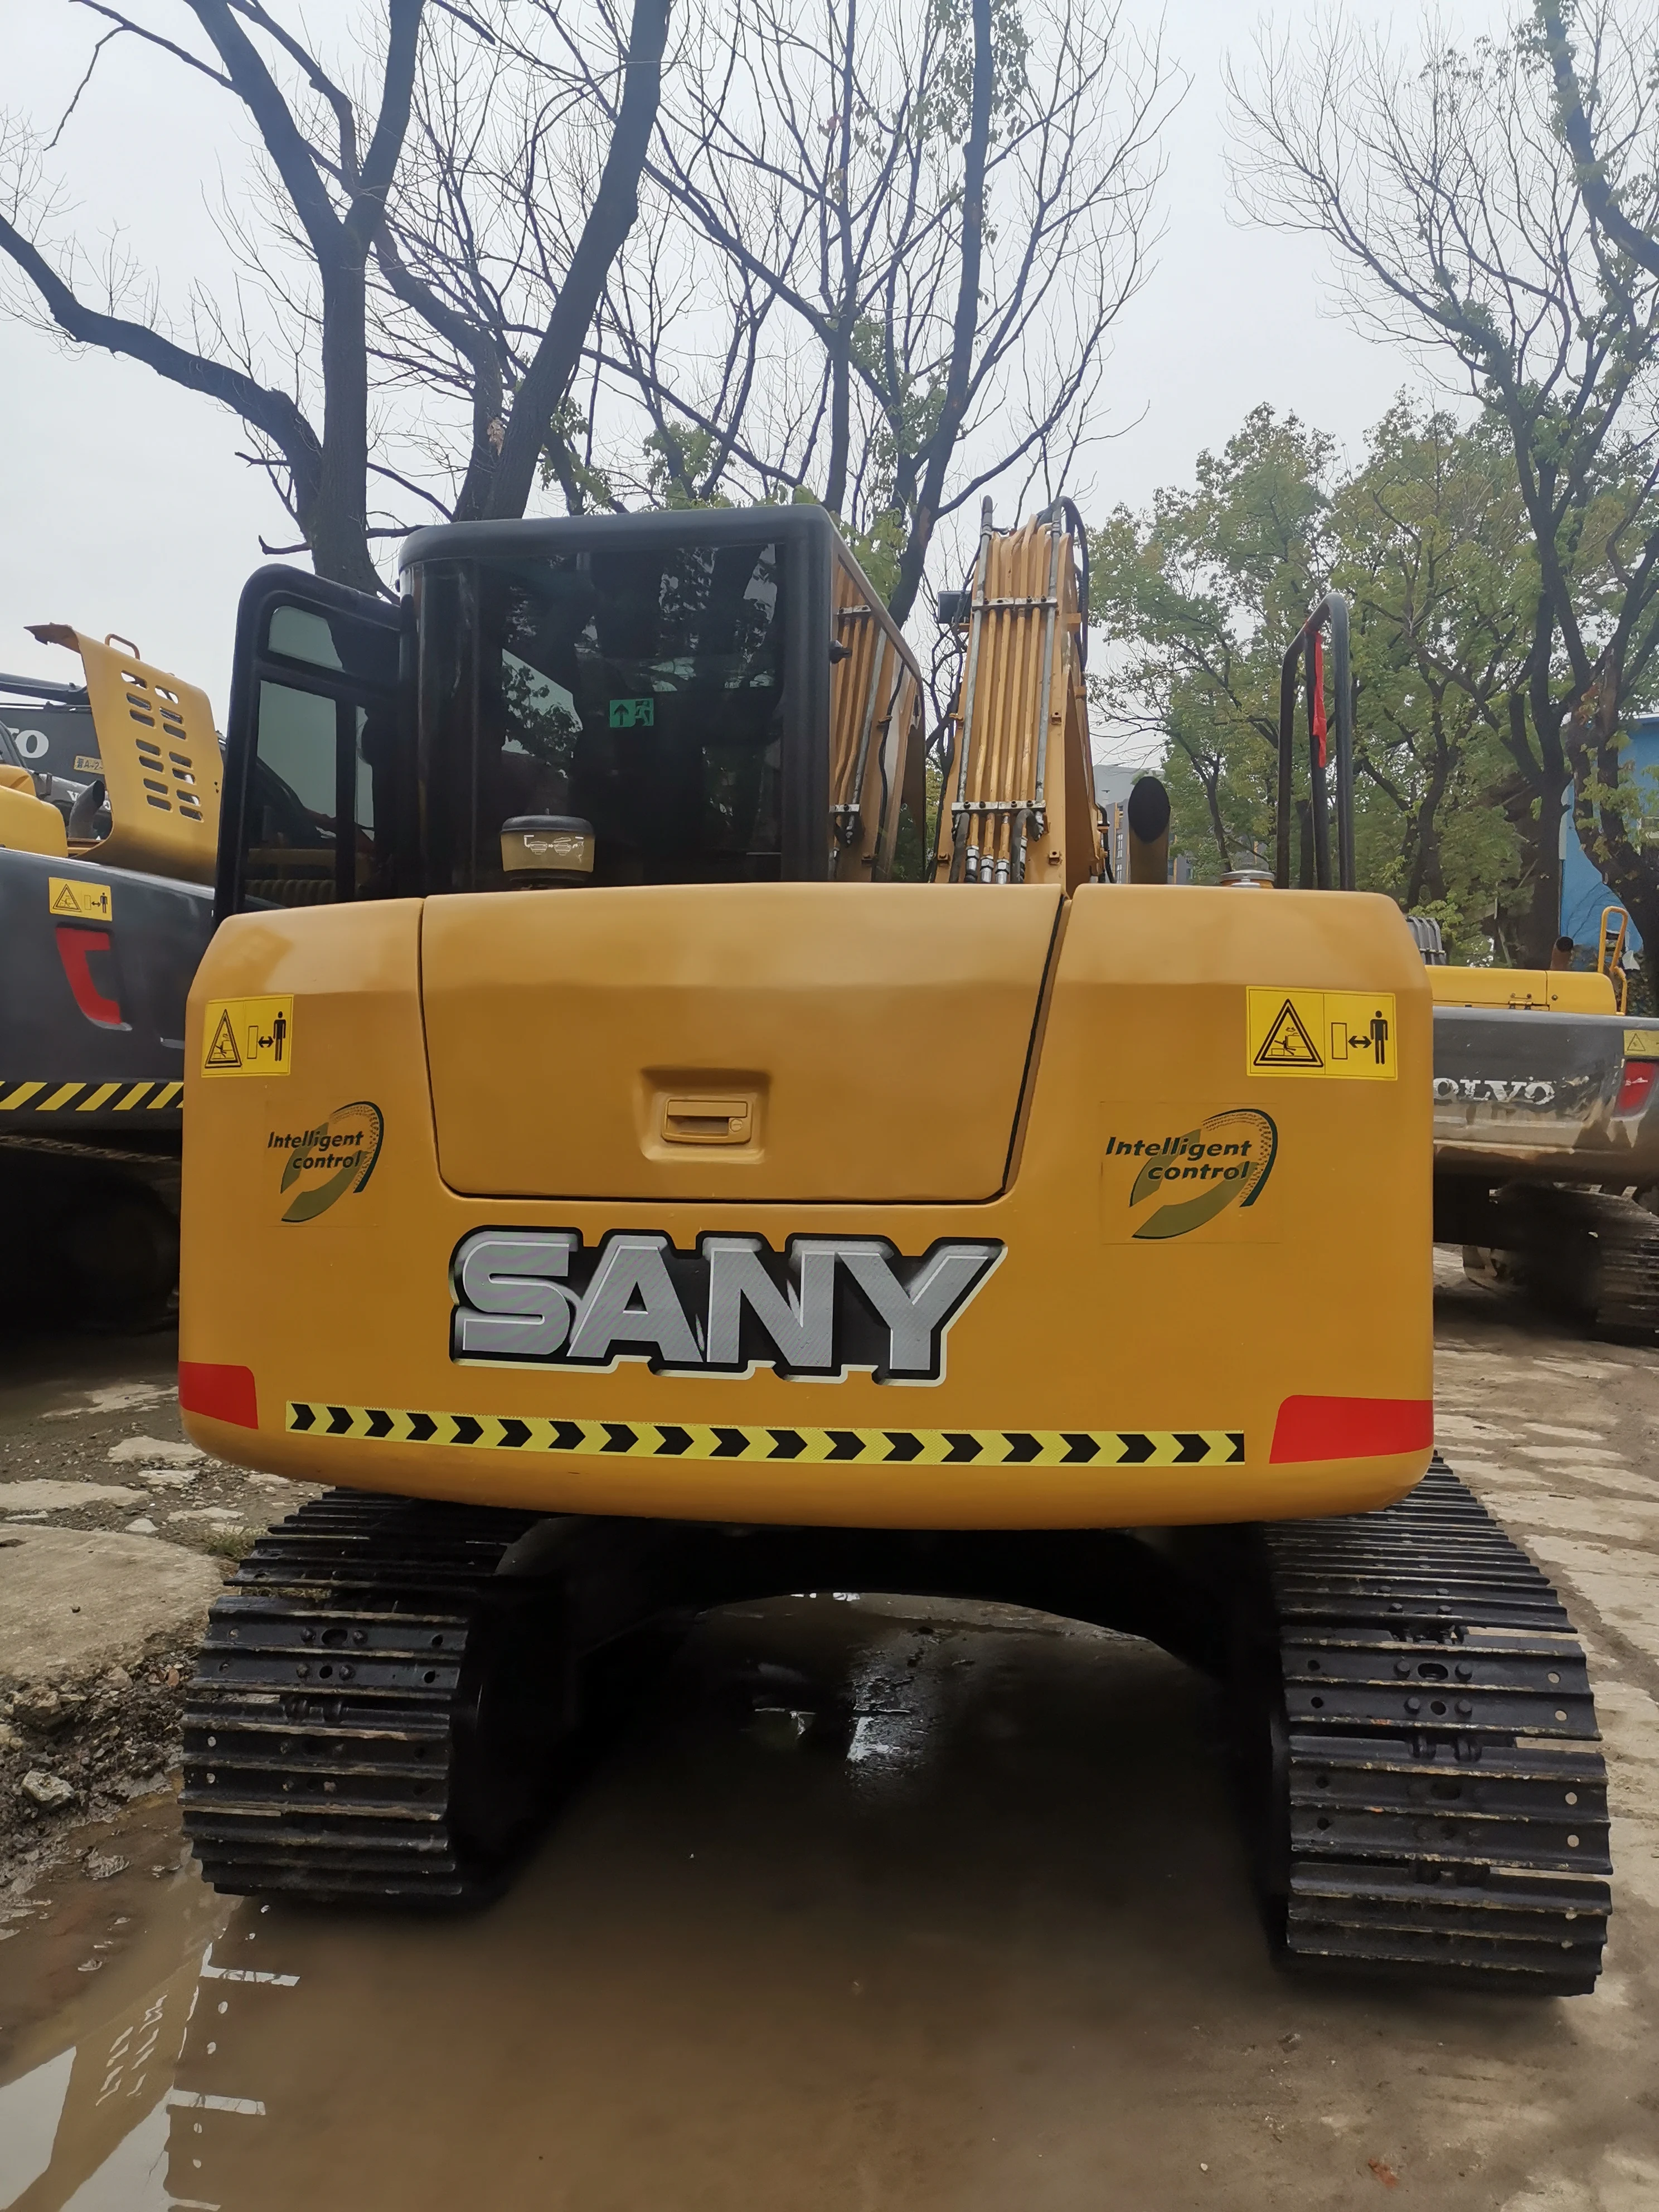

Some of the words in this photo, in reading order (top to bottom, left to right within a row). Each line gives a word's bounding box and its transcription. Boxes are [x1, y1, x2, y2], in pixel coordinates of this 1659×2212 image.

[268, 1131, 364, 1151] Intelligent
[1105, 1137, 1252, 1161] Intelligent
[293, 1150, 361, 1168] control
[1148, 1161, 1250, 1180] control
[455, 1231, 1001, 1377] SANY
